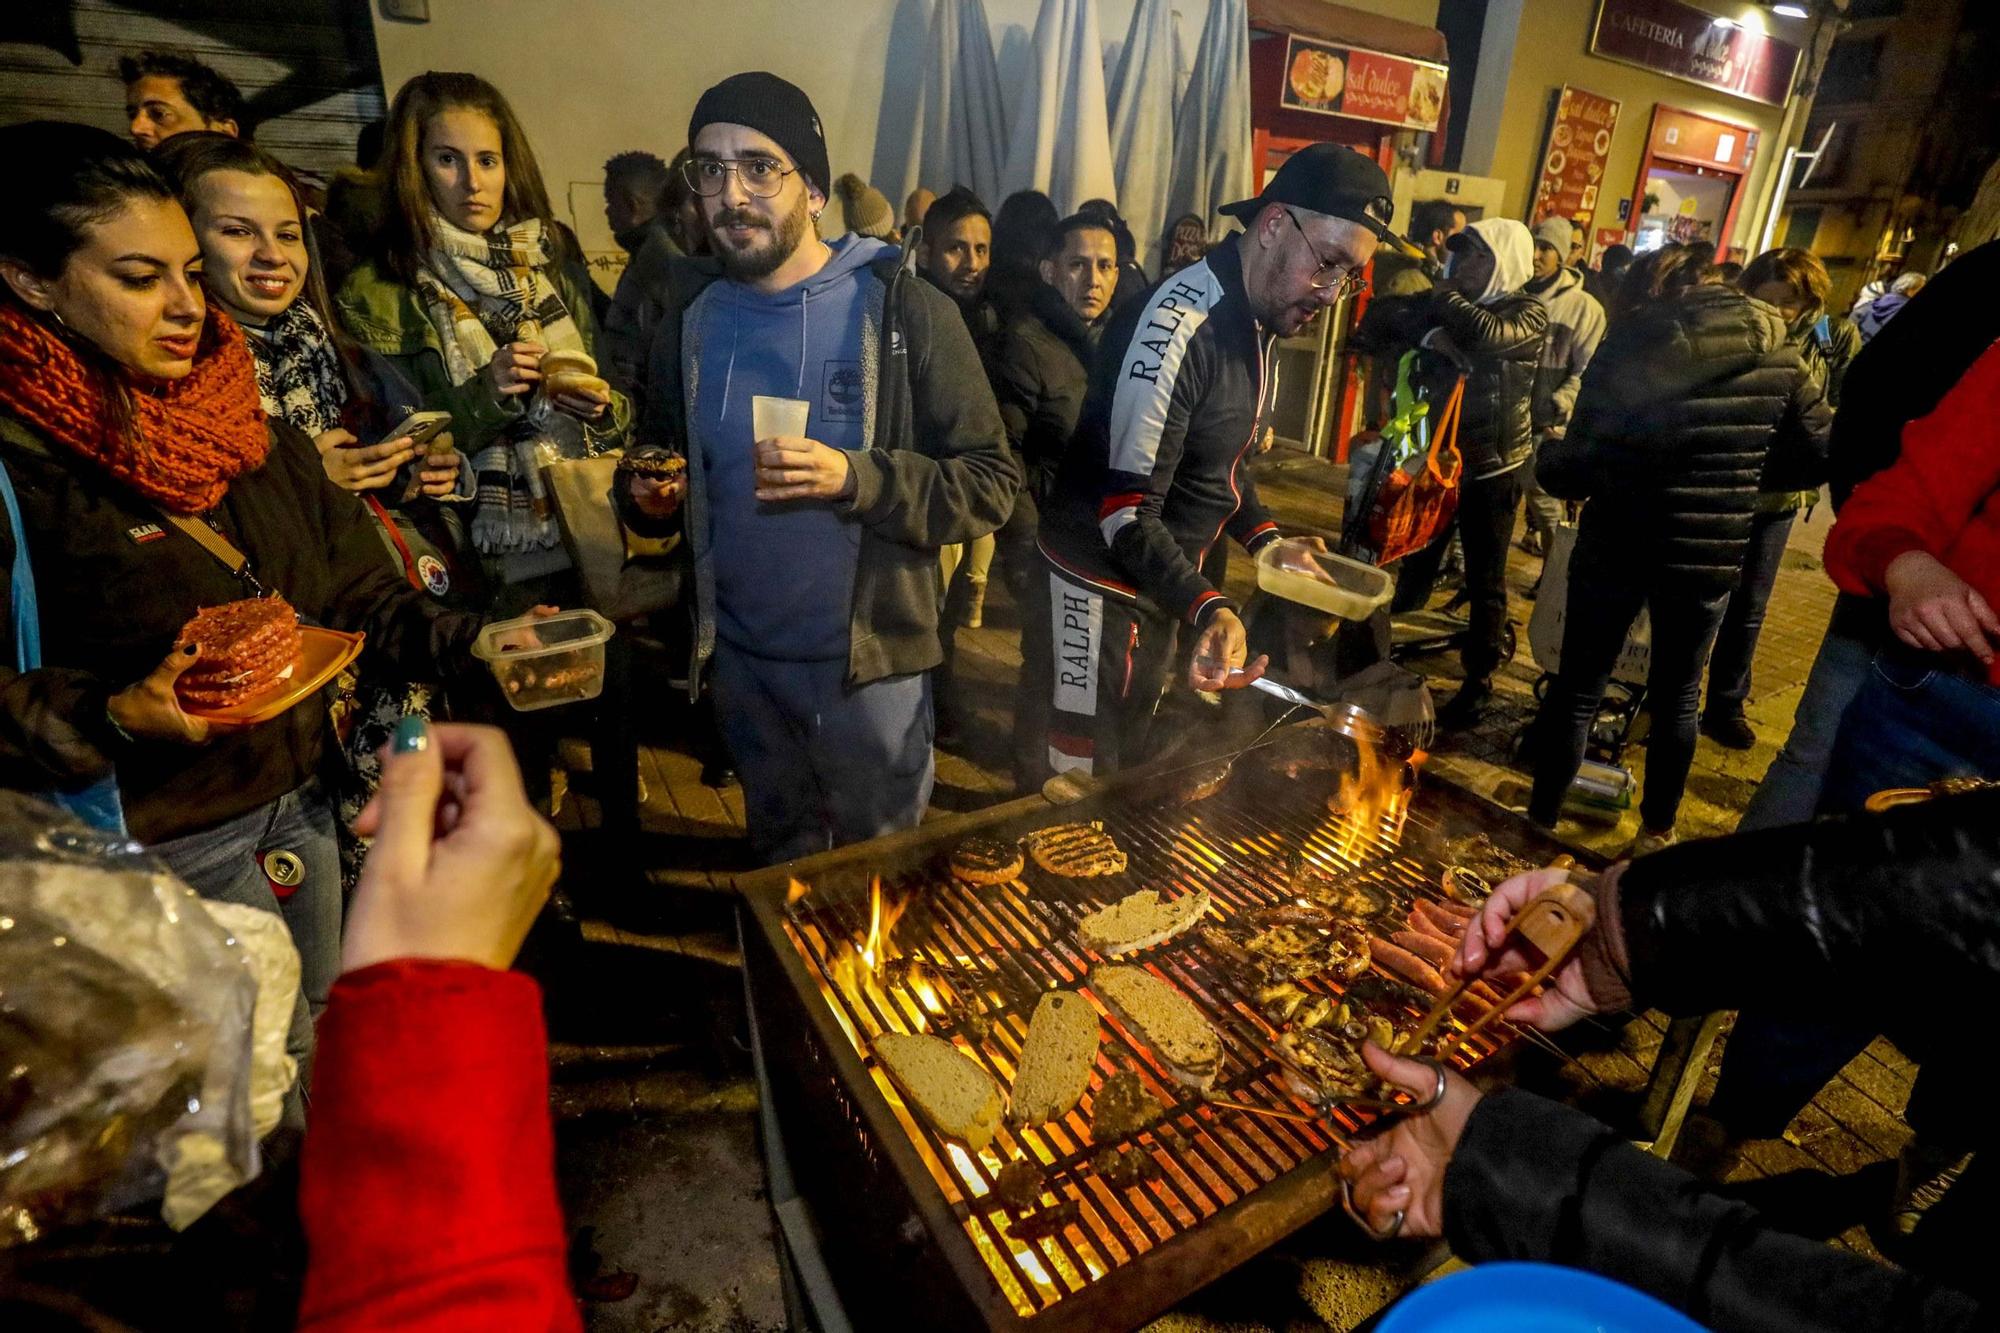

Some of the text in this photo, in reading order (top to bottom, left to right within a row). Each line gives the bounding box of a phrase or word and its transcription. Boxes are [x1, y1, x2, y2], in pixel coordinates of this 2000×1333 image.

[1610, 12, 1684, 48] CAFETERÍA
[1349, 63, 1401, 96] sal dulce
[1129, 282, 1206, 386] RALPH
[1060, 592, 1091, 691] RALPH
